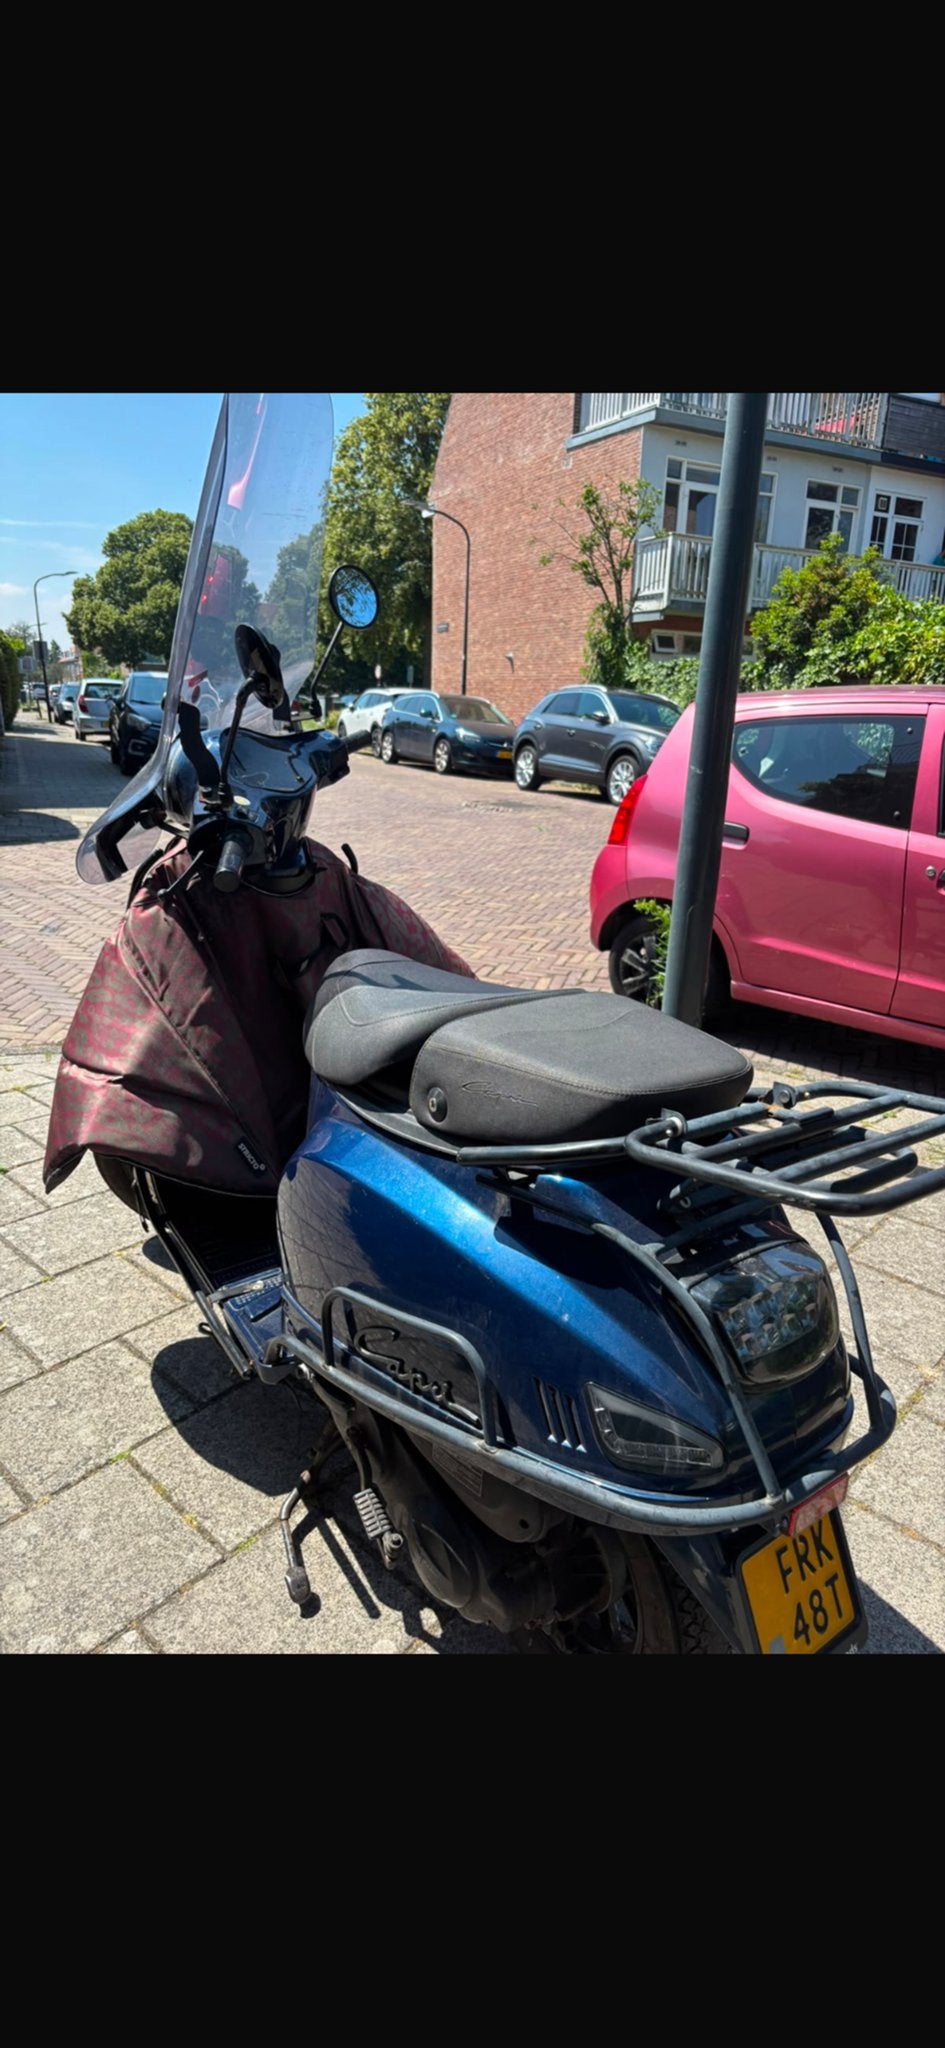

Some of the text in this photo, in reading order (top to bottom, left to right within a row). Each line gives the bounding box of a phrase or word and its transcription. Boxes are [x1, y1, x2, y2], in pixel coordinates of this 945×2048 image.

[237, 1142, 260, 1170] STRICTO
[775, 1518, 834, 1594] FRK
[794, 1572, 843, 1646] 48T
